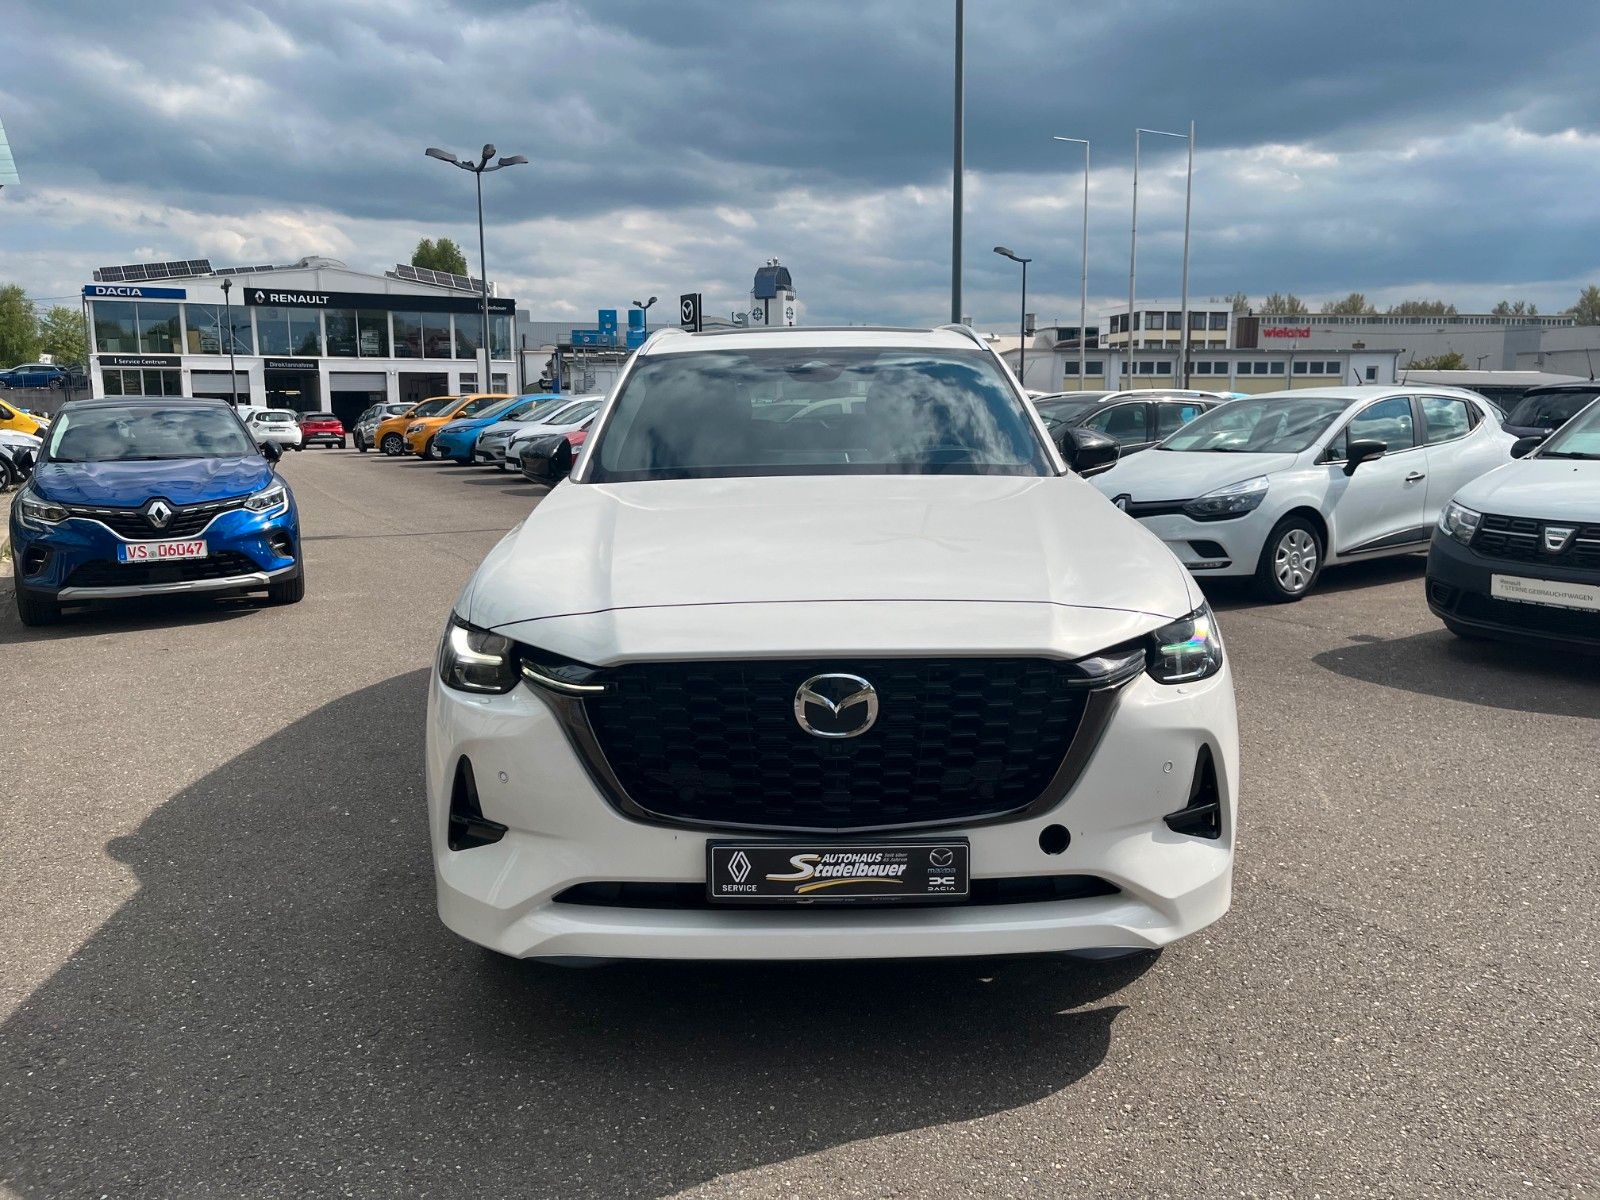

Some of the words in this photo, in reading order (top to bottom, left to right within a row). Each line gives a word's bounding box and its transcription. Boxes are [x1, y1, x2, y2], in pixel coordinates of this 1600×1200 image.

[95, 286, 142, 297] DACIA
[269, 293, 330, 304] RENAULT
[1263, 326, 1311, 338] wieland
[118, 357, 141, 365] Service
[269, 361, 315, 369] Direktannahme
[127, 545, 148, 559] VS
[158, 542, 203, 557] 06047
[1528, 588, 1594, 601] GEBRAUCHTWAGEN
[821, 852, 883, 863] AUTOHAUS
[766, 853, 908, 881] Stadelbauer
[722, 884, 758, 892] SERVICE
